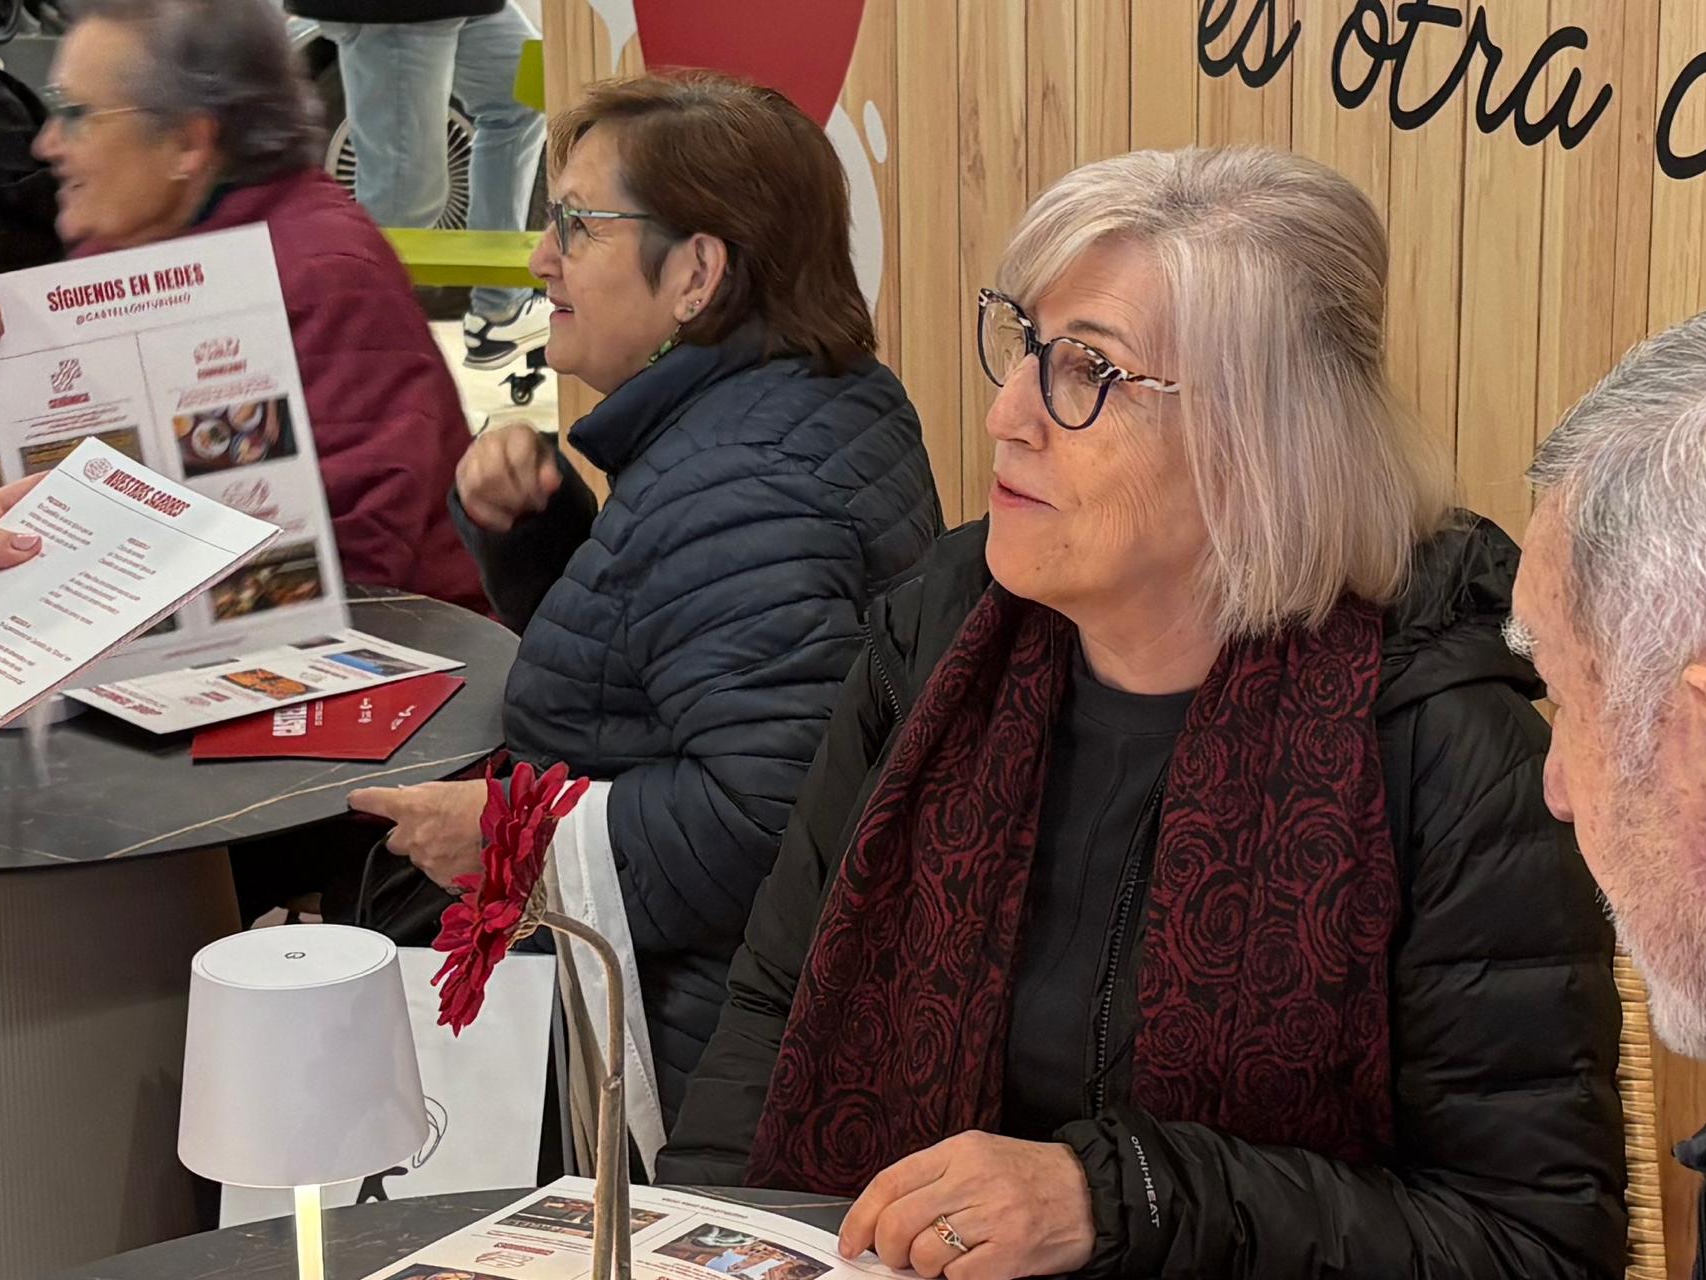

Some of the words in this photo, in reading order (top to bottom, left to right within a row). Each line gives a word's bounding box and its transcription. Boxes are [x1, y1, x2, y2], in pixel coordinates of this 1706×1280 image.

[46, 278, 126, 312] SÍGUENOS
[130, 274, 152, 296] EN
[154, 262, 205, 290] REDES
[1131, 1135, 1160, 1229] OMNI-HEAT
